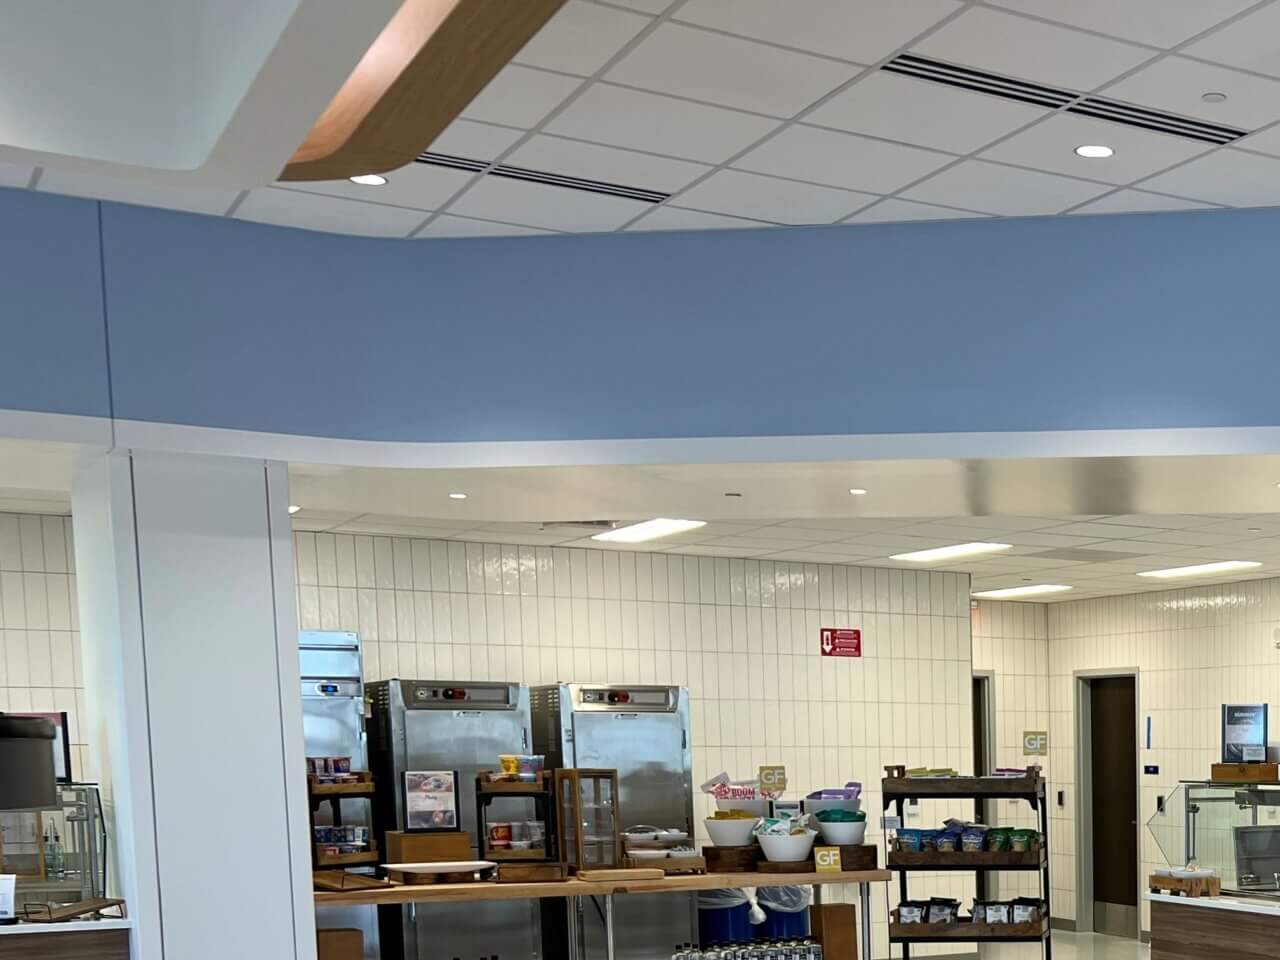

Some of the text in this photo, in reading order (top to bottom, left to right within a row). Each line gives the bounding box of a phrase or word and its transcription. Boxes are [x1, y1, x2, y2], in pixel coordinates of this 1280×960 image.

[1024, 735, 1046, 749] GF
[761, 769, 785, 784] GF
[817, 851, 839, 865] GF
